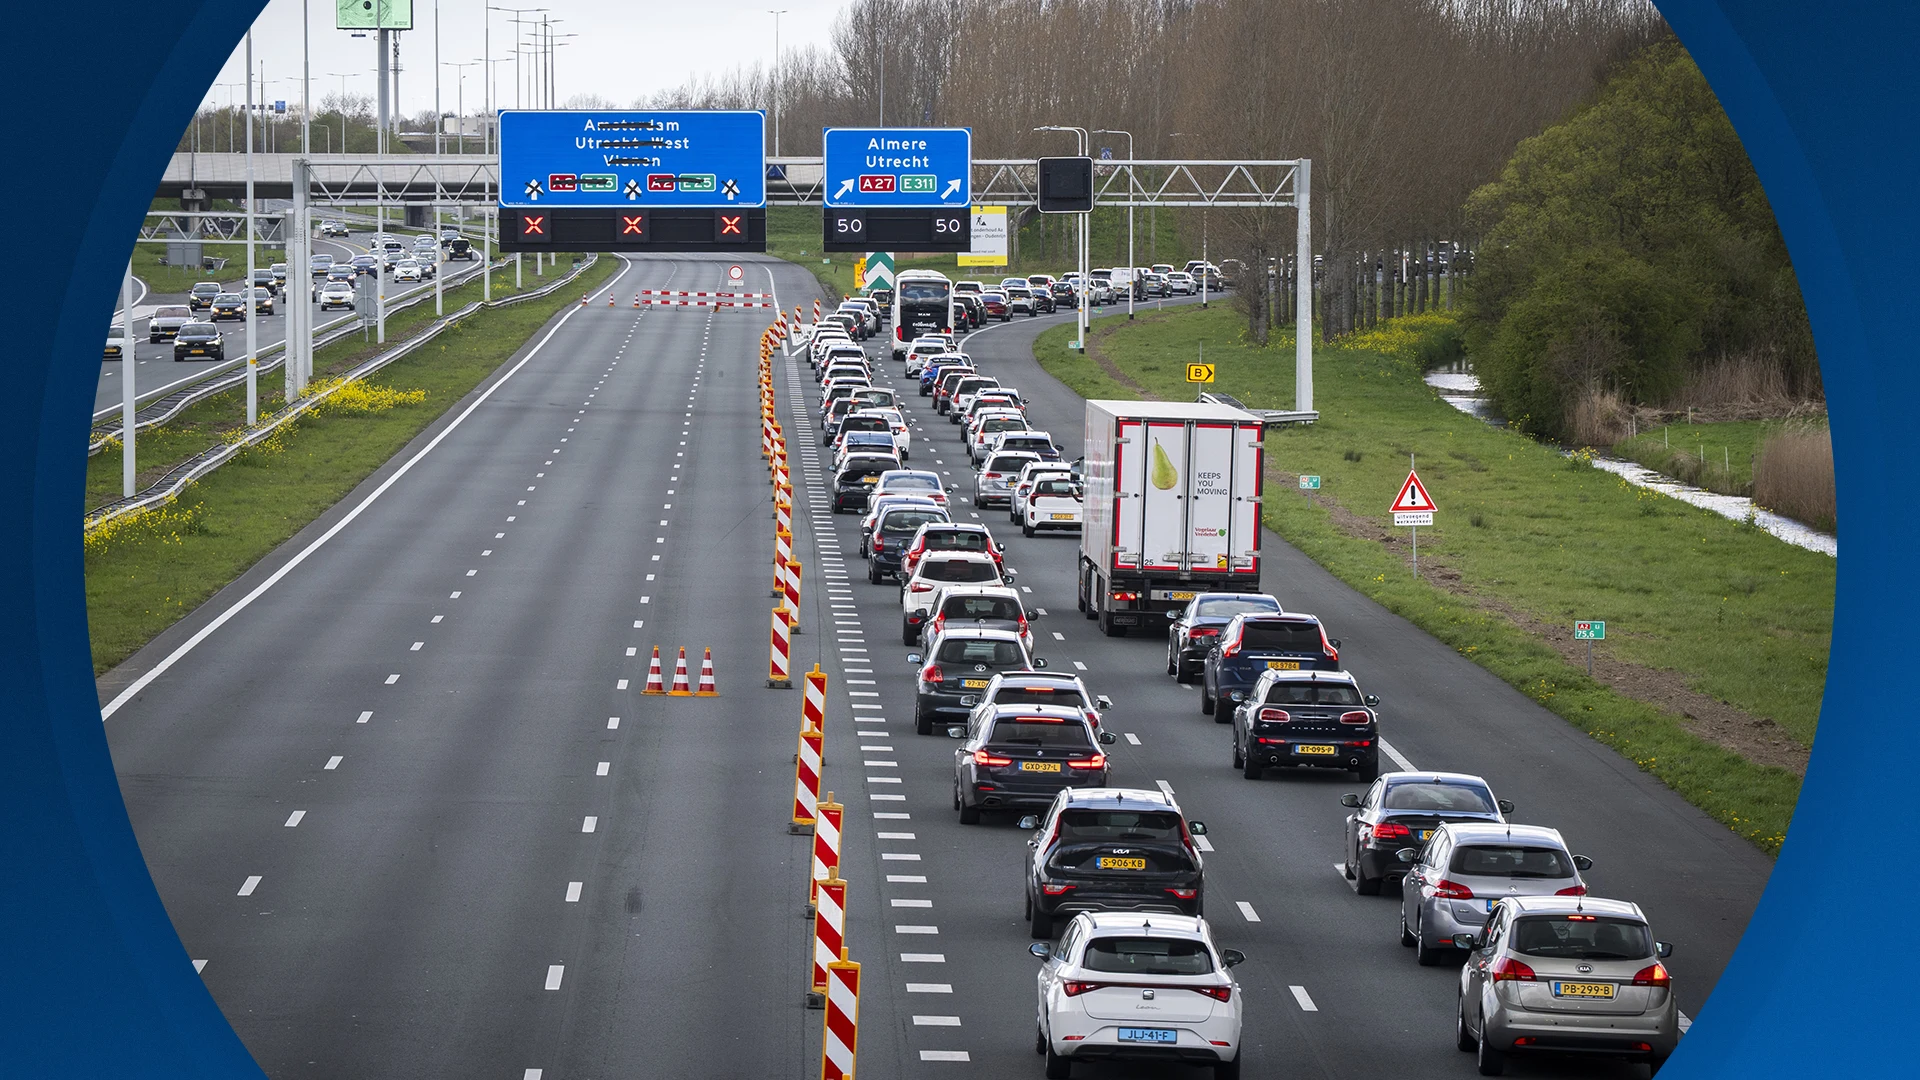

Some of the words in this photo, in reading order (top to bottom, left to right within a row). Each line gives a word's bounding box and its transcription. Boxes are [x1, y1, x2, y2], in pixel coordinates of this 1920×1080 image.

[868, 138, 927, 150] Almere
[866, 155, 929, 168] Utrecht
[837, 219, 862, 233] 50
[935, 219, 960, 233] 50
[1195, 368, 1202, 377] B
[1025, 763, 1058, 771] GXD-37-L
[1102, 858, 1143, 867] S-906-KB
[1563, 984, 1610, 995] PB-299-B
[1128, 1030, 1168, 1040] JLJ-41-F
